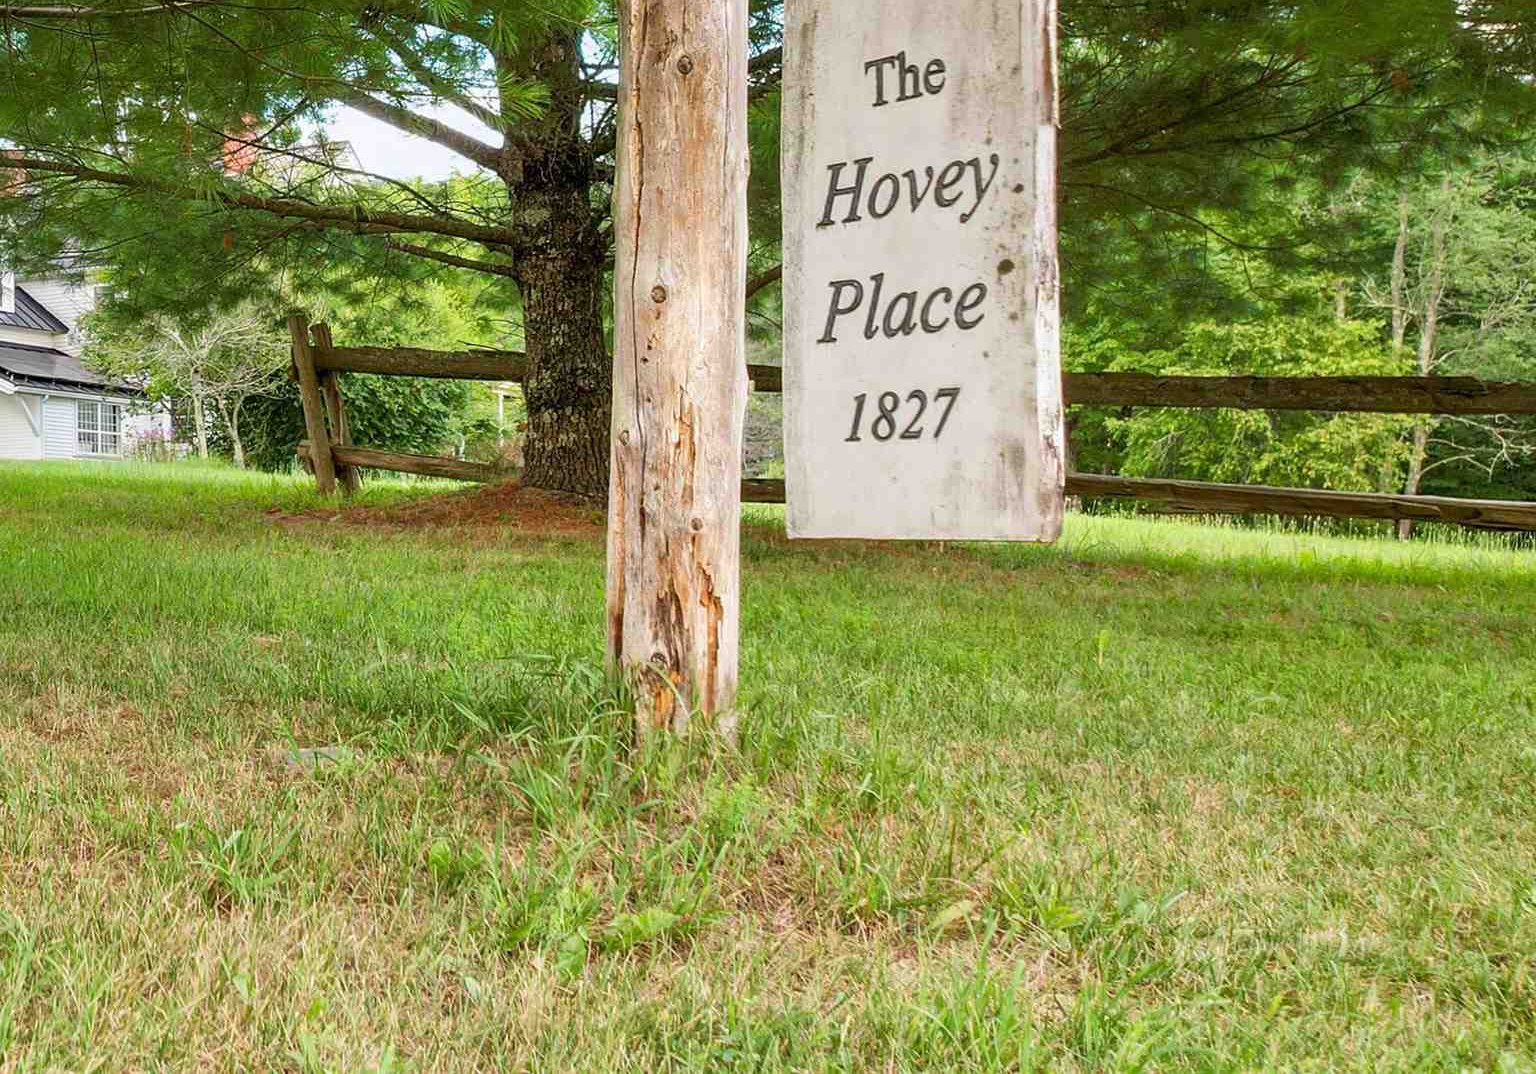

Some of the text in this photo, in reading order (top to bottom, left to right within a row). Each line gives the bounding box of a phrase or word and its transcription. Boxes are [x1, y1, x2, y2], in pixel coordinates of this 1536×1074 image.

[864, 50, 947, 107] The
[815, 153, 1000, 229] Hovey
[816, 272, 988, 344] Place
[844, 386, 961, 443] 1827
